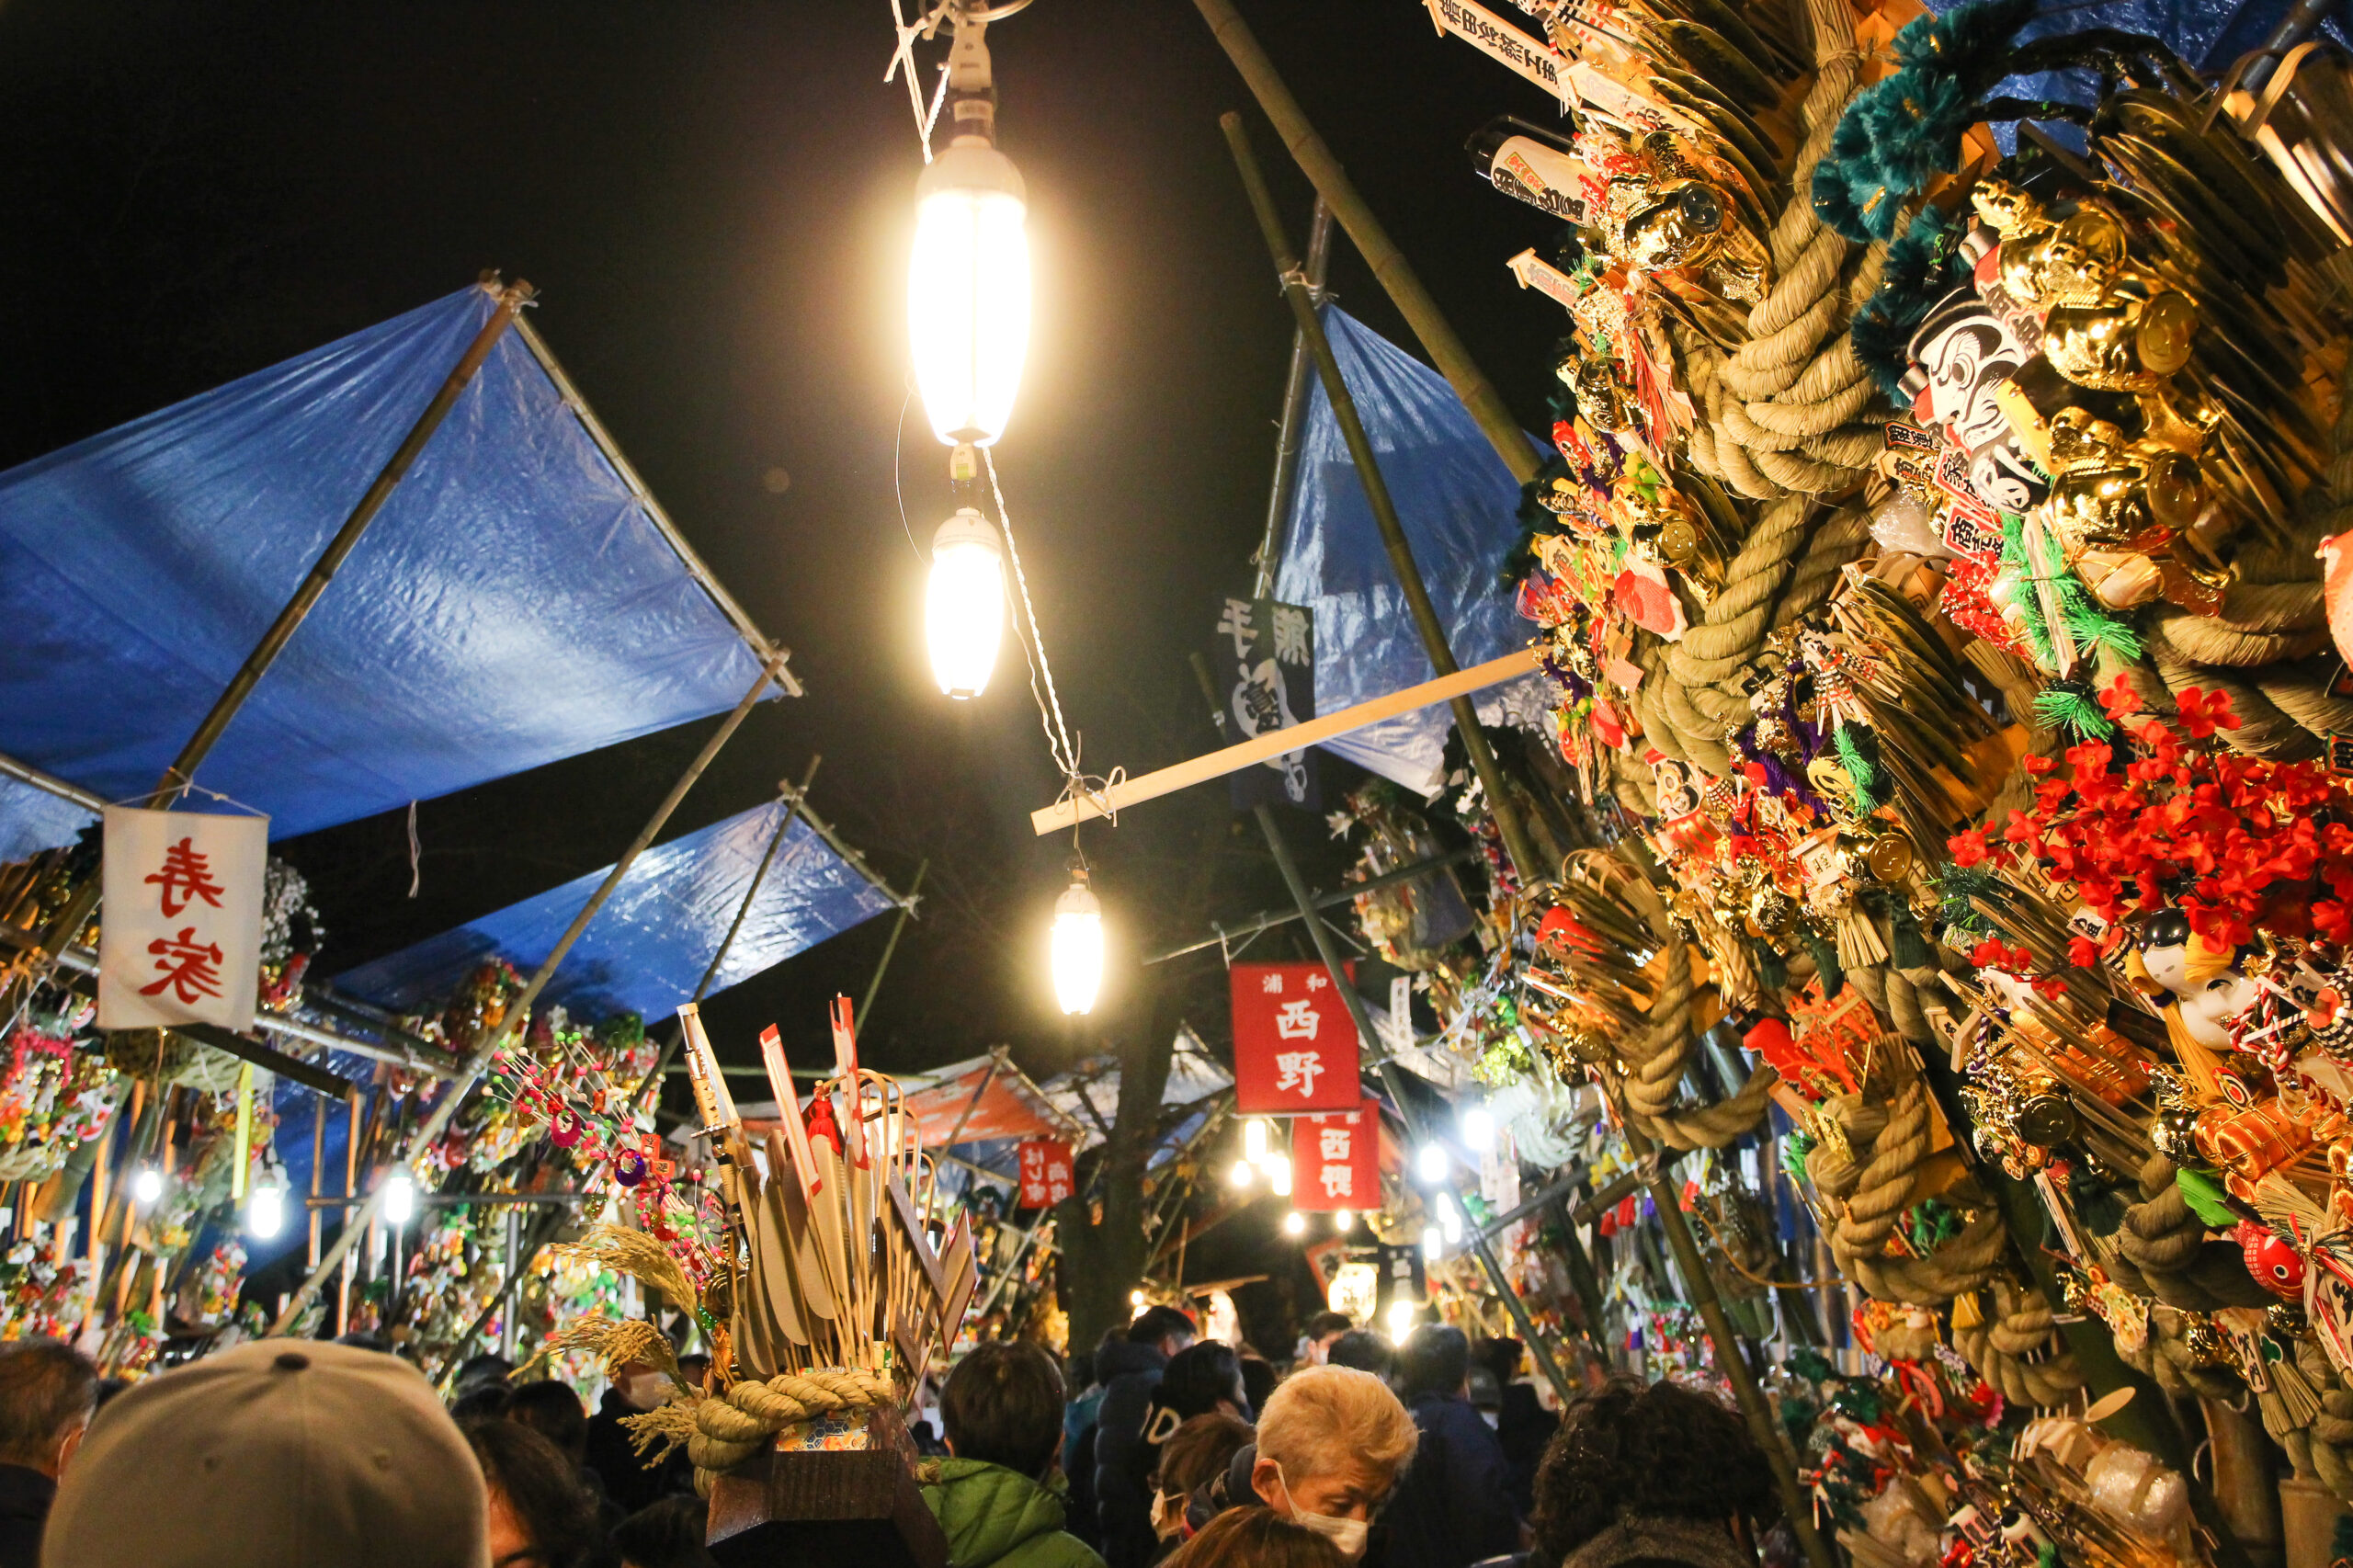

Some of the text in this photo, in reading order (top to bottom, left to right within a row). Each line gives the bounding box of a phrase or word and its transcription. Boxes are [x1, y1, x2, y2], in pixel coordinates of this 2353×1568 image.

[1888, 424, 1940, 450] 開運
[1263, 973, 1328, 994] 浦和
[1275, 999, 1325, 1098] 西野
